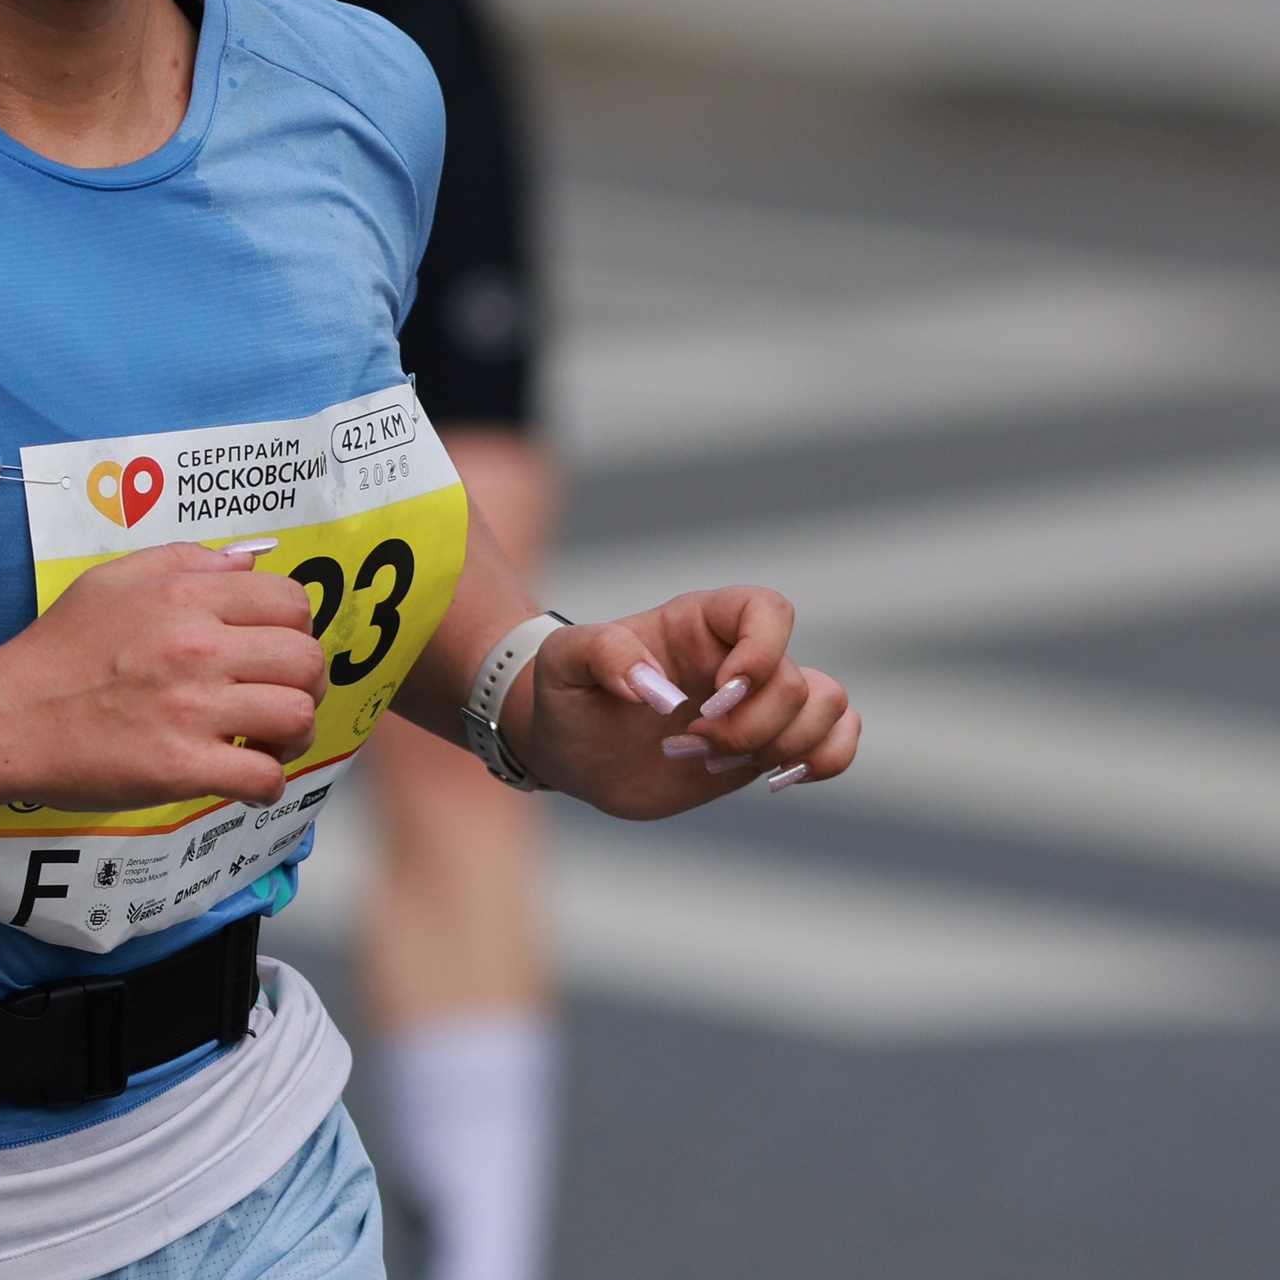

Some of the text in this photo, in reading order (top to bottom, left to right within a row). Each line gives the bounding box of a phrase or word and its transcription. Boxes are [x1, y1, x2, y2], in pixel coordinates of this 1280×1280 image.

[341, 412, 407, 452] 42,2 КМ
[177, 438, 301, 468] СБЕРПРАЙМ
[178, 451, 328, 496] МОСКОВСКИЙ
[358, 454, 410, 491] 2026
[178, 488, 297, 523] МАРАФОН
[270, 800, 301, 821] СБЕР
[122, 876, 148, 886] города
[124, 867, 150, 877] спорта
[9, 849, 81, 928] F
[139, 903, 165, 922] BRICS
